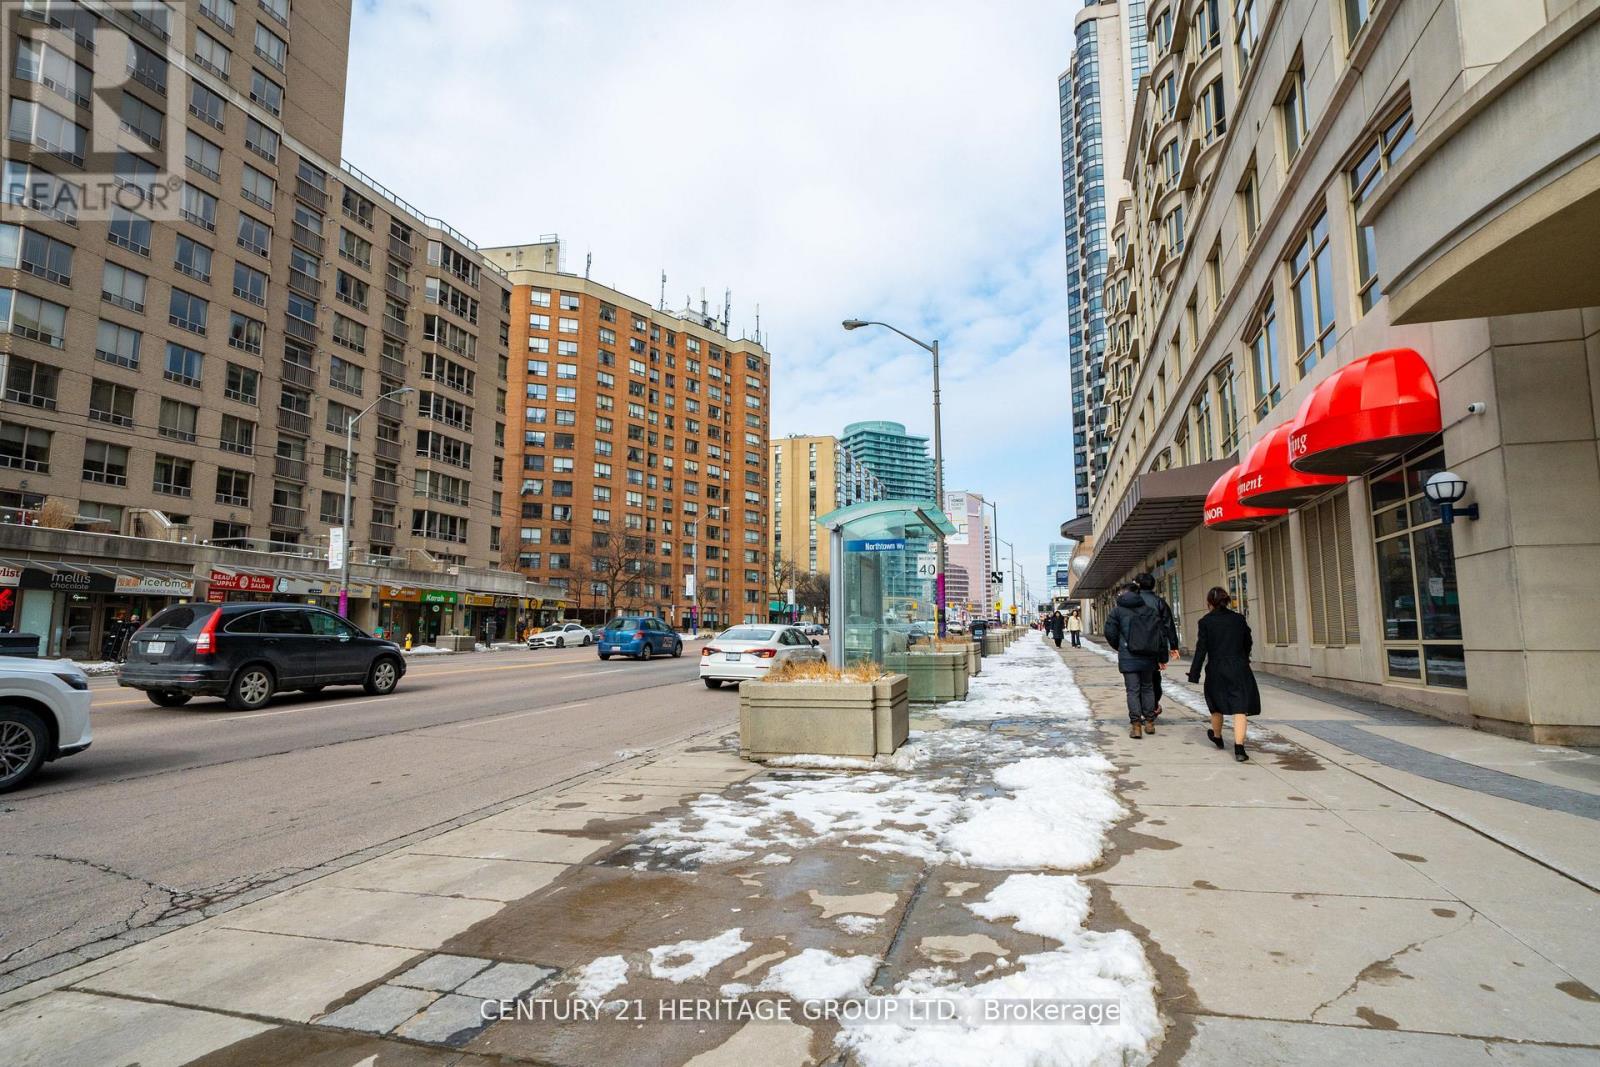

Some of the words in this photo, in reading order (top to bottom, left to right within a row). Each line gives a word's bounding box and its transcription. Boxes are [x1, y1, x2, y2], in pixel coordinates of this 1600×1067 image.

[864, 542, 895, 551] Northtown
[919, 564, 936, 576] 40
[51, 571, 92, 584] mellis
[213, 573, 239, 581] BEAUTY
[50, 581, 89, 590] chocolate
[212, 579, 237, 587] UPPLY
